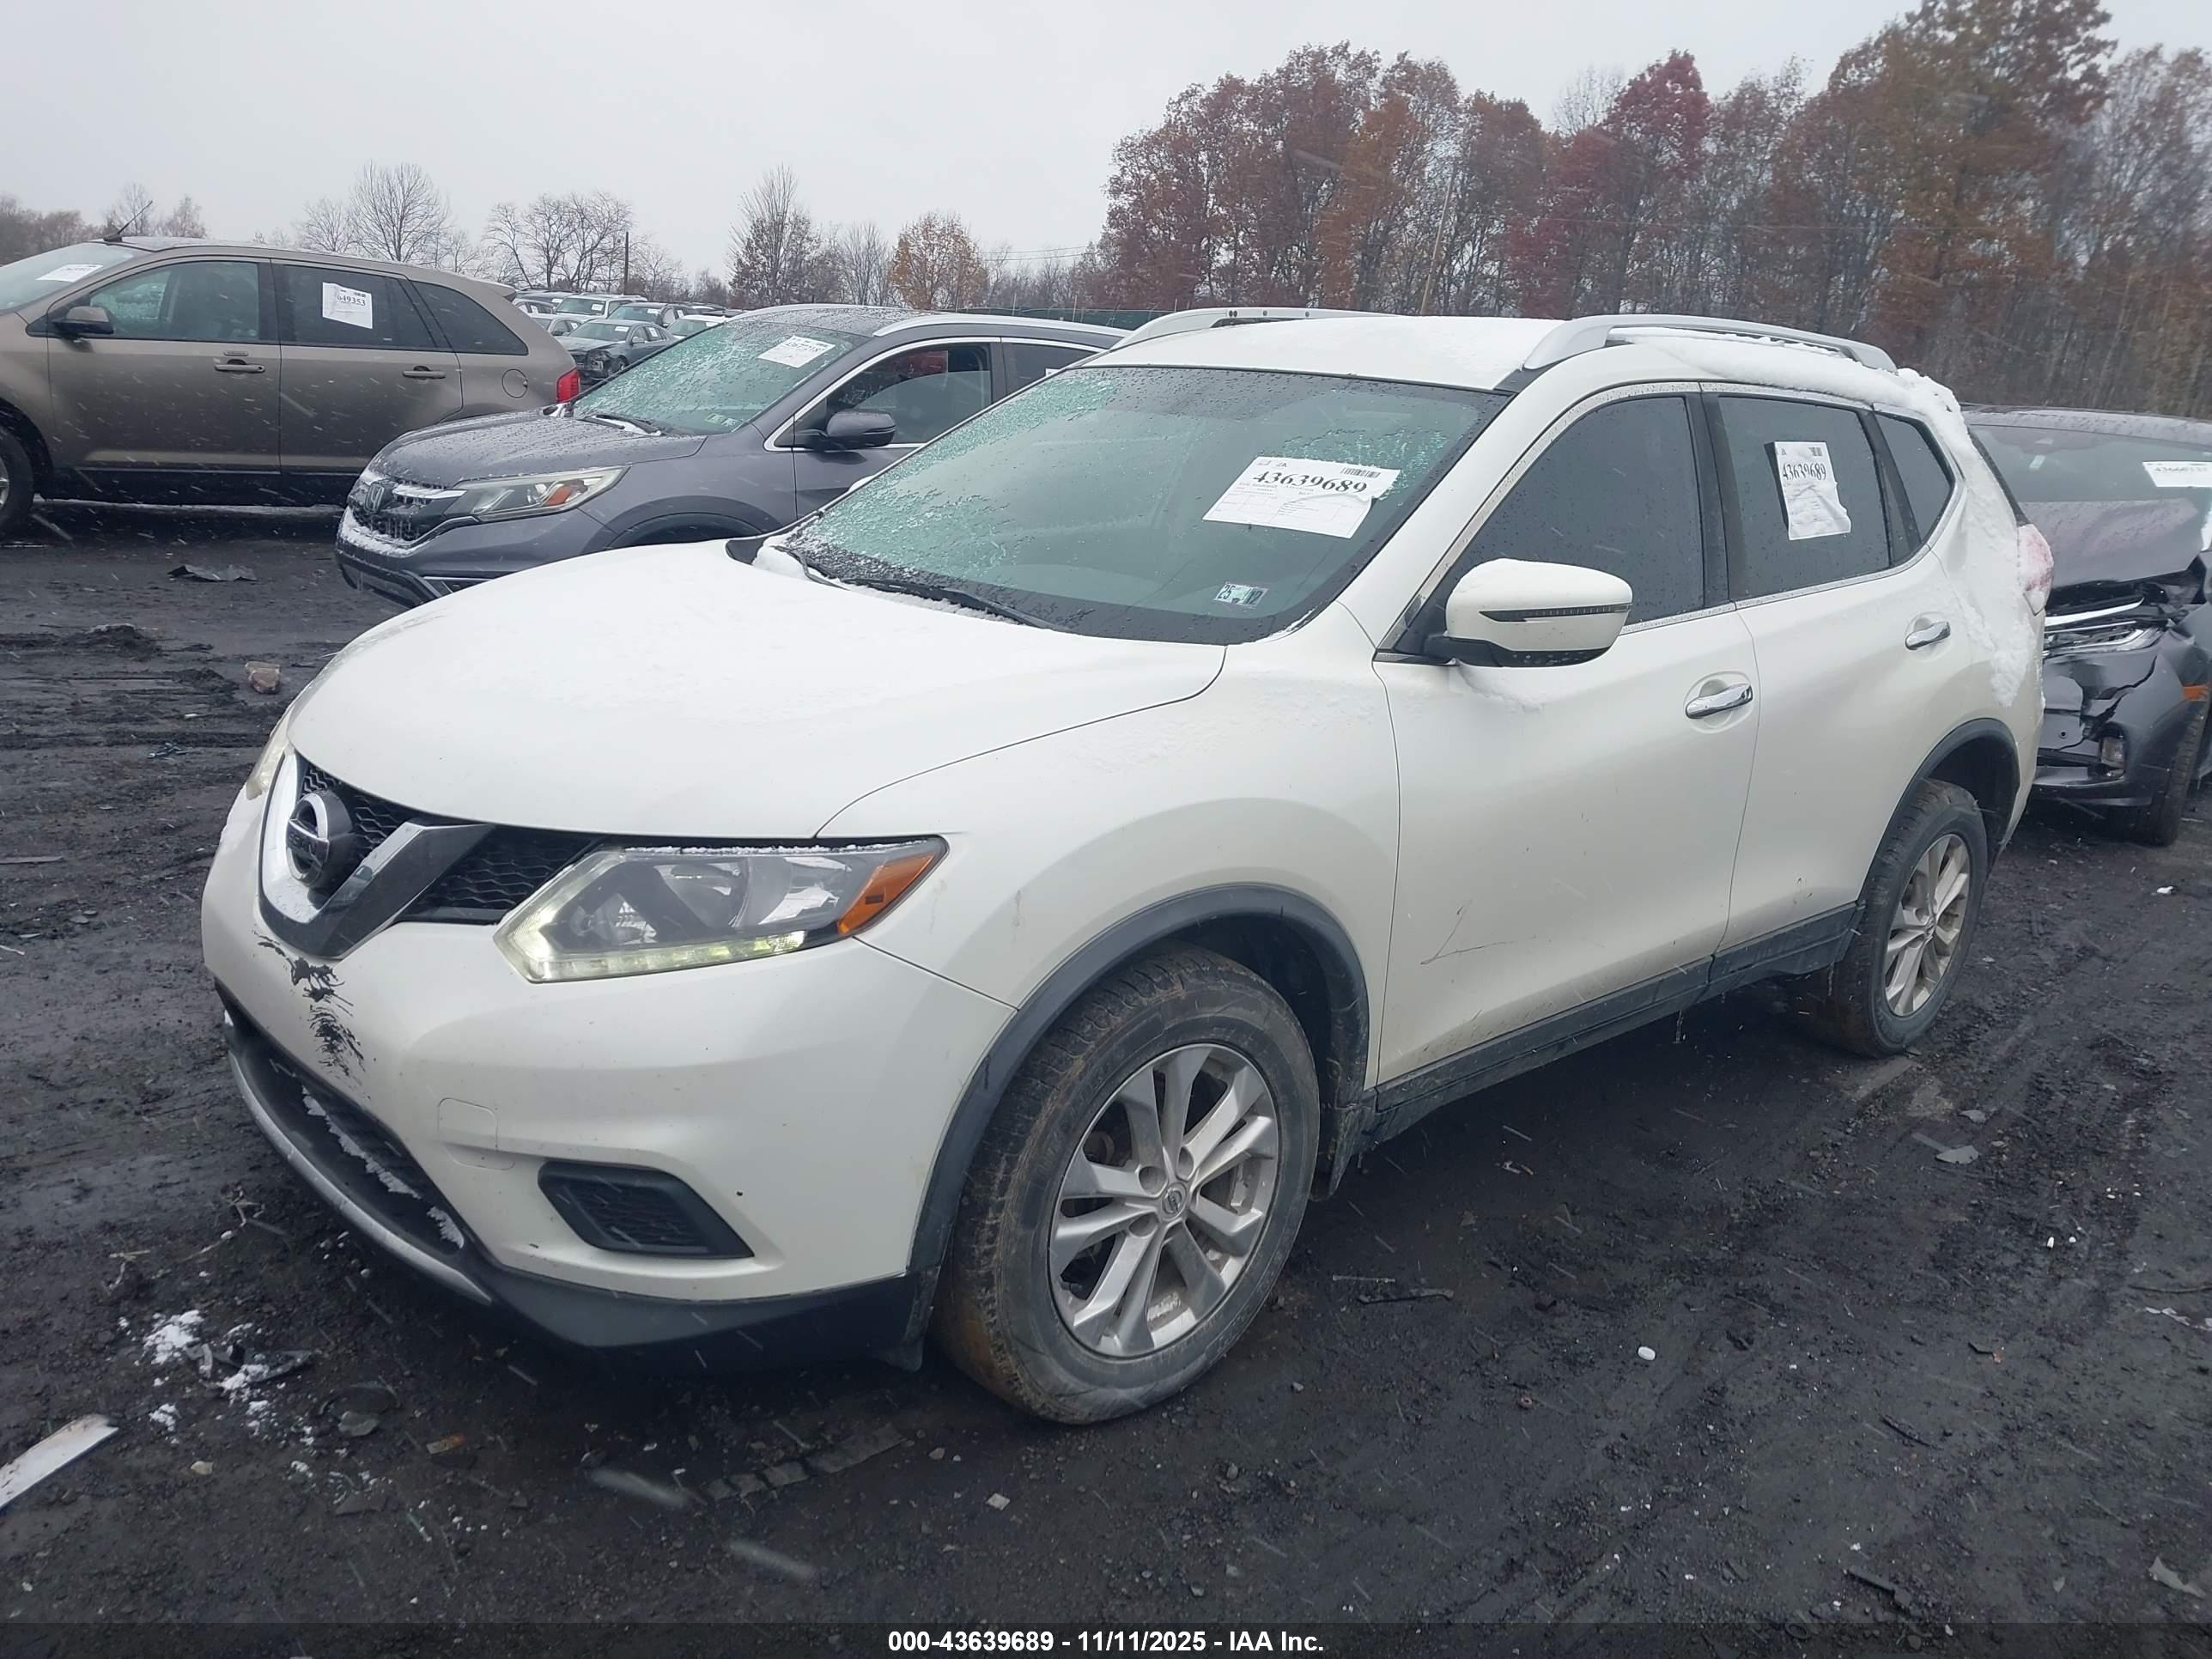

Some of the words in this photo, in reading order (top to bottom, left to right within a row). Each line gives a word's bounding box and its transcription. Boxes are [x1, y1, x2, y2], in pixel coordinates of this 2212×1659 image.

[1782, 462, 1826, 481] 43639689
[1252, 471, 1368, 494] 43639689
[1218, 584, 1236, 599] 25
